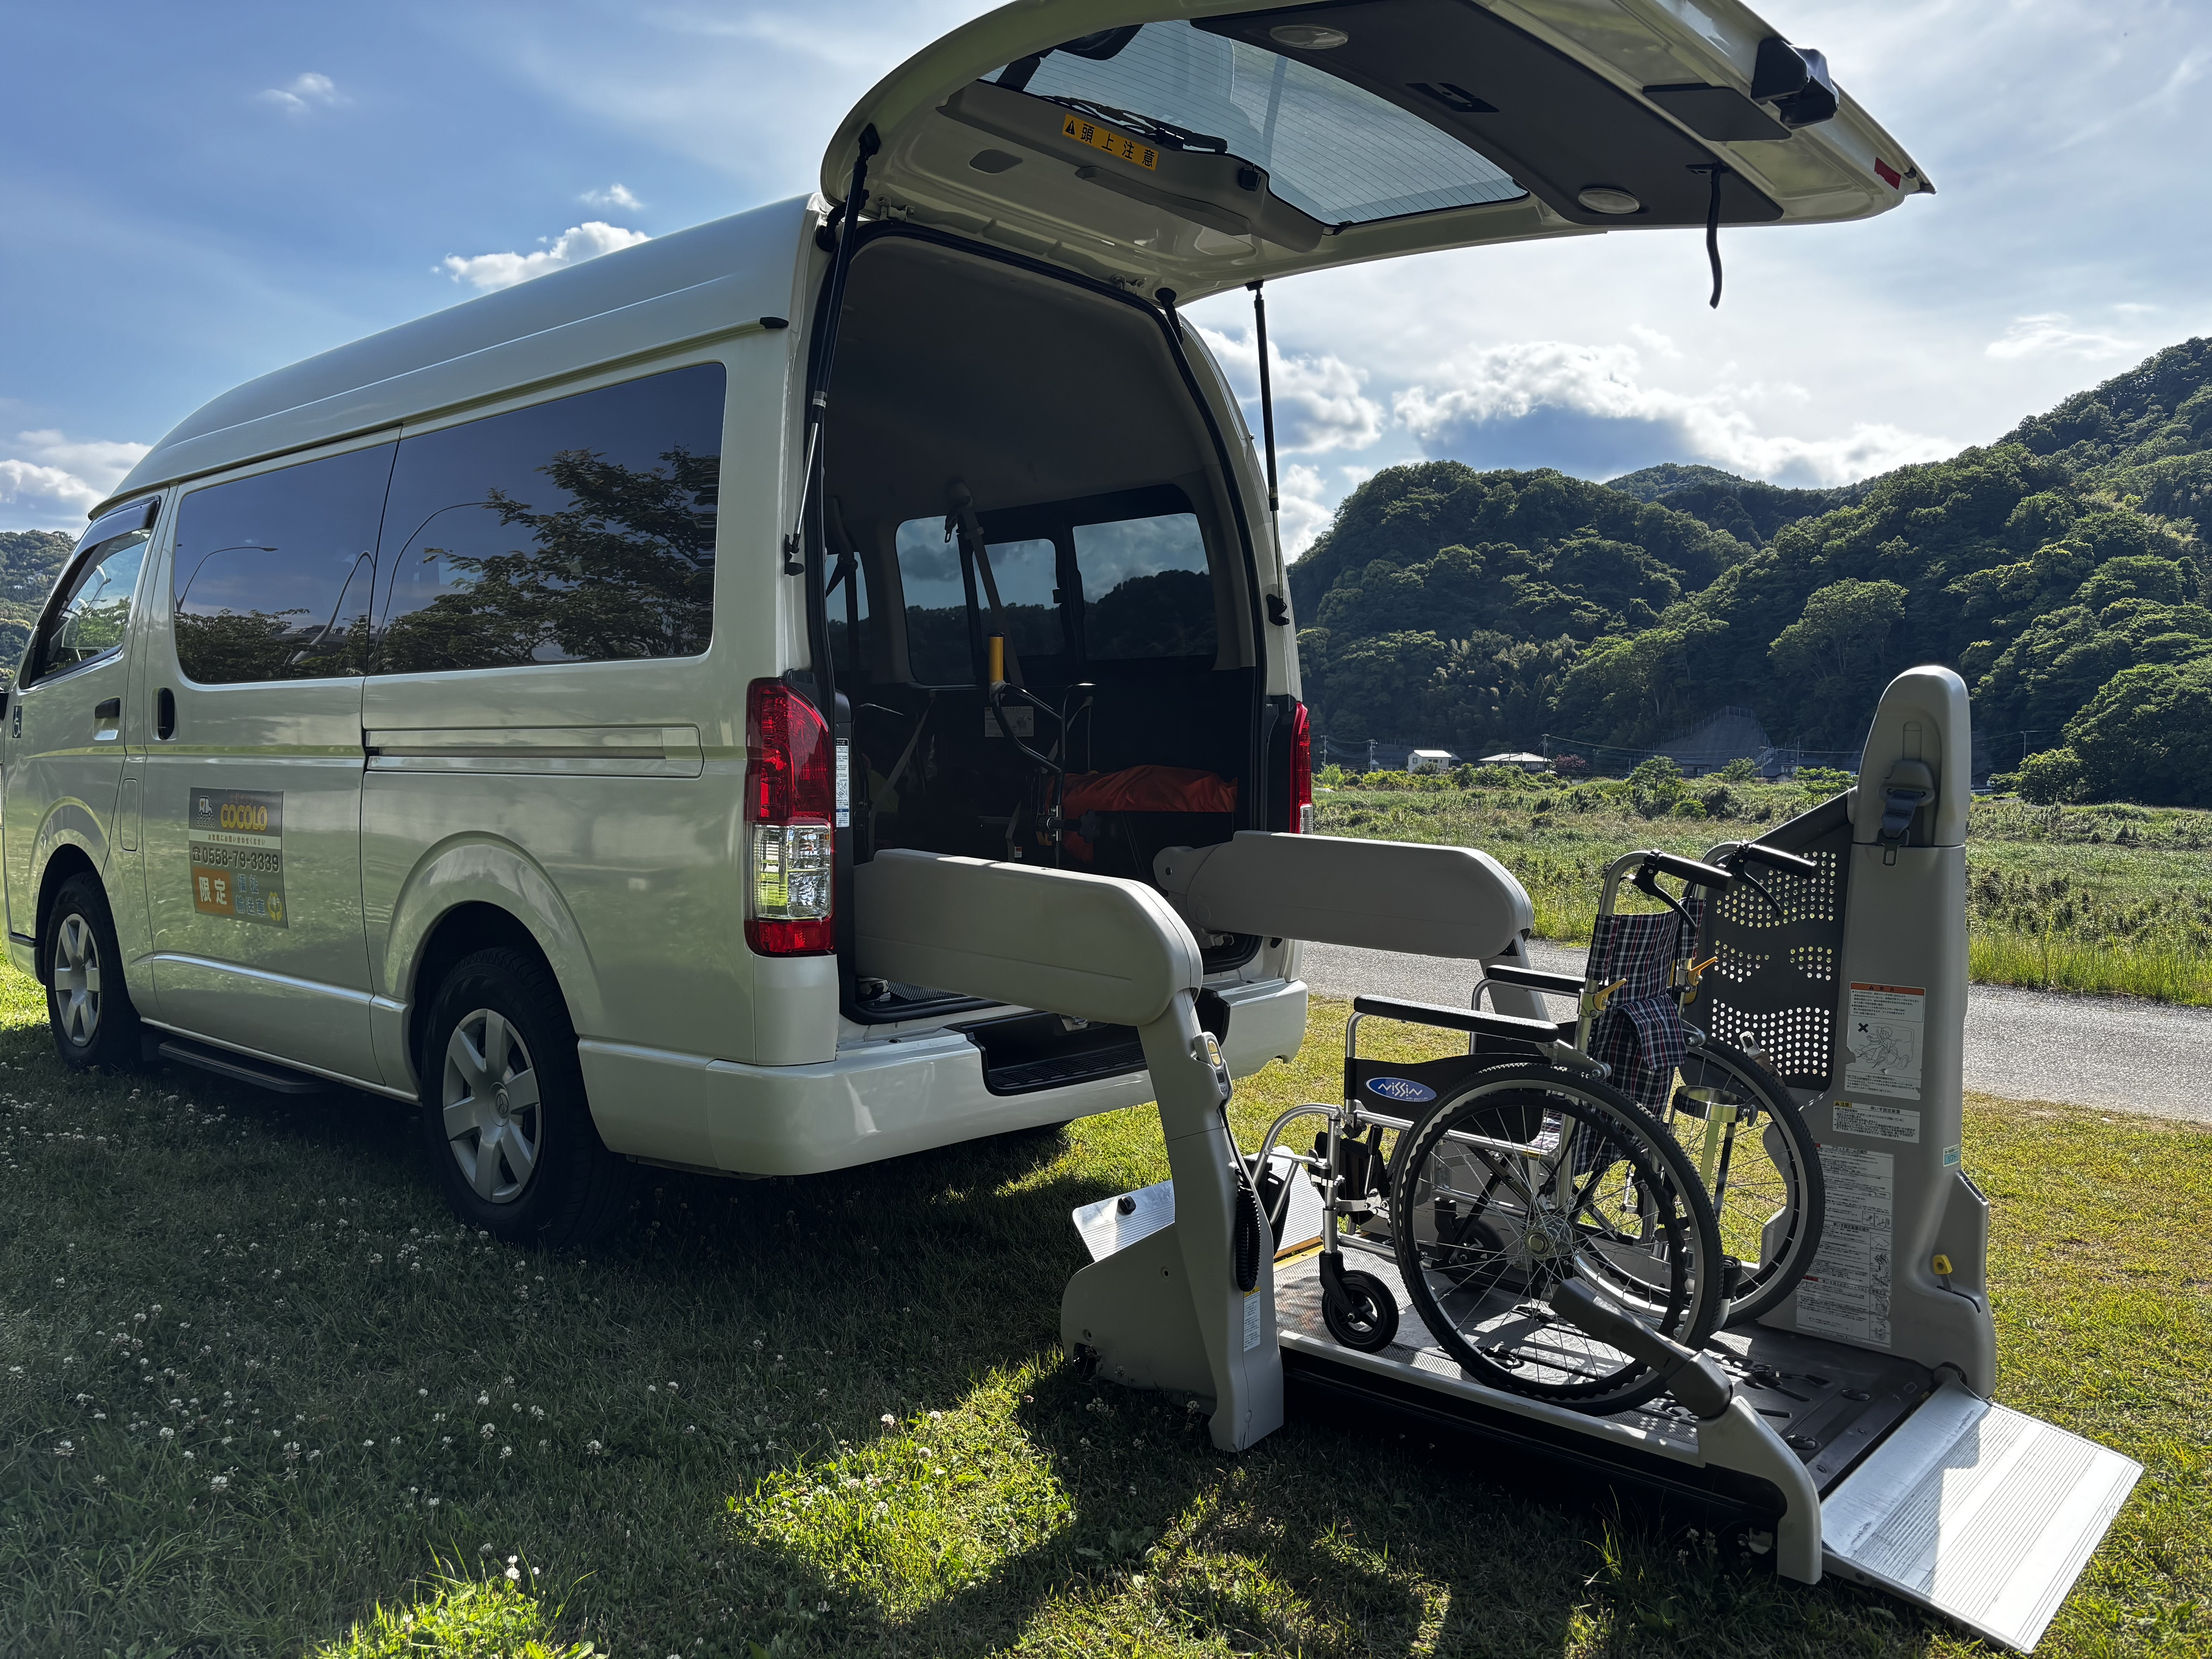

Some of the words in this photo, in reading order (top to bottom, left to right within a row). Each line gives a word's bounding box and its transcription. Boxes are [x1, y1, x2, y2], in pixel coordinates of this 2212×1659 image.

[1080, 123, 1154, 168] 頭上注意
[220, 804, 268, 830] COCOLO
[203, 847, 279, 872] 0558-79-3339
[199, 876, 227, 905] 限定
[238, 873, 259, 893] 福祉
[236, 895, 266, 917] 輸送車
